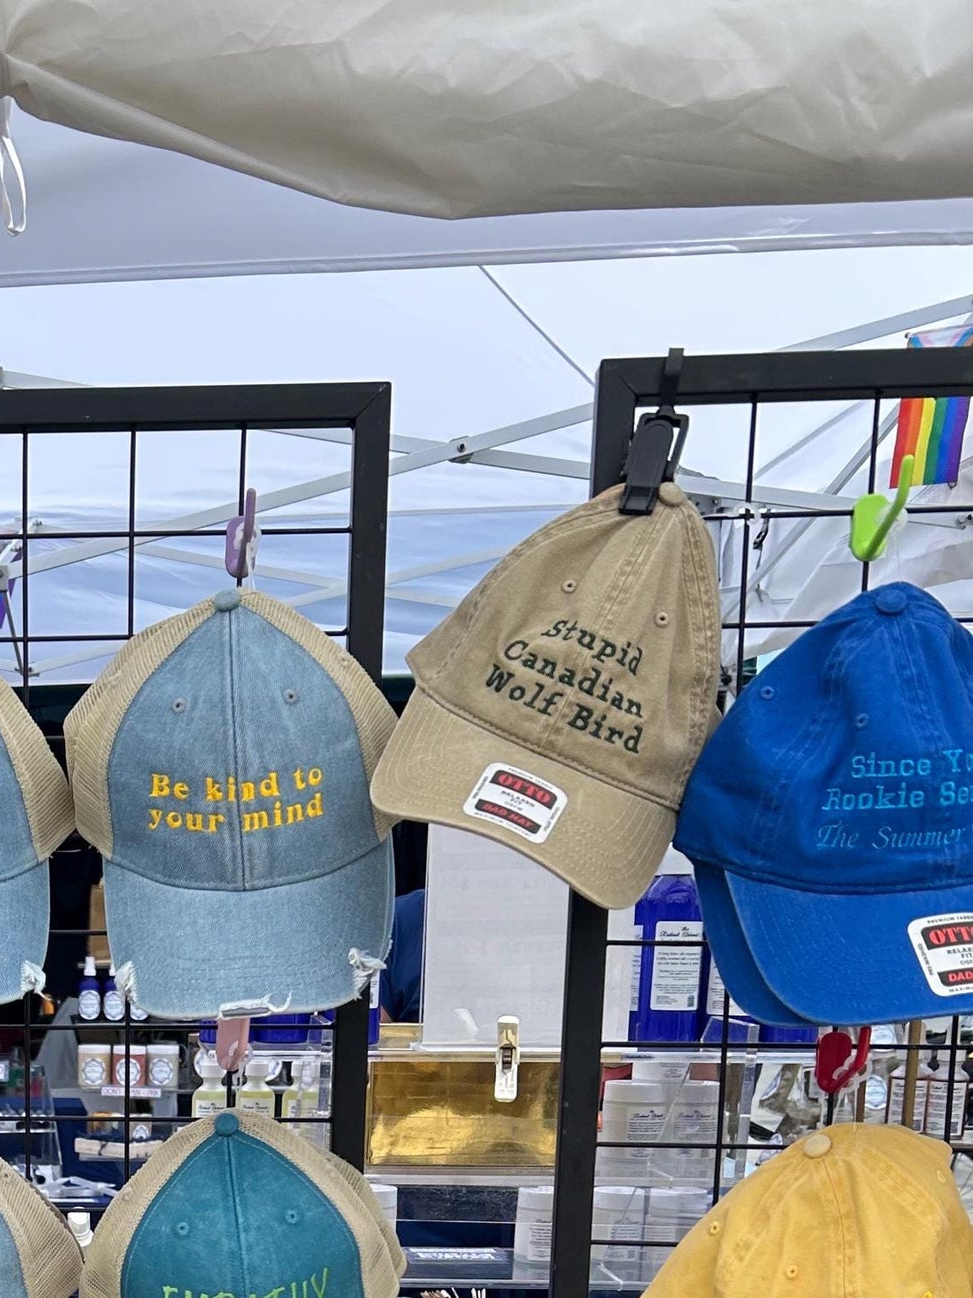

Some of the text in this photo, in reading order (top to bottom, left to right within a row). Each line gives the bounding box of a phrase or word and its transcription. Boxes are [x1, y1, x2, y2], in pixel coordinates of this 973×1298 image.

[504, 640, 643, 718] Canadian
[485, 663, 644, 754] Wolf Bird
[851, 751, 932, 778] Since
[149, 767, 322, 801] Be kind to
[498, 774, 550, 803] OTTO
[821, 781, 973, 811] Rookie Se
[148, 792, 323, 833] your mind
[816, 820, 966, 849] The Summer
[929, 926, 973, 945] OTT
